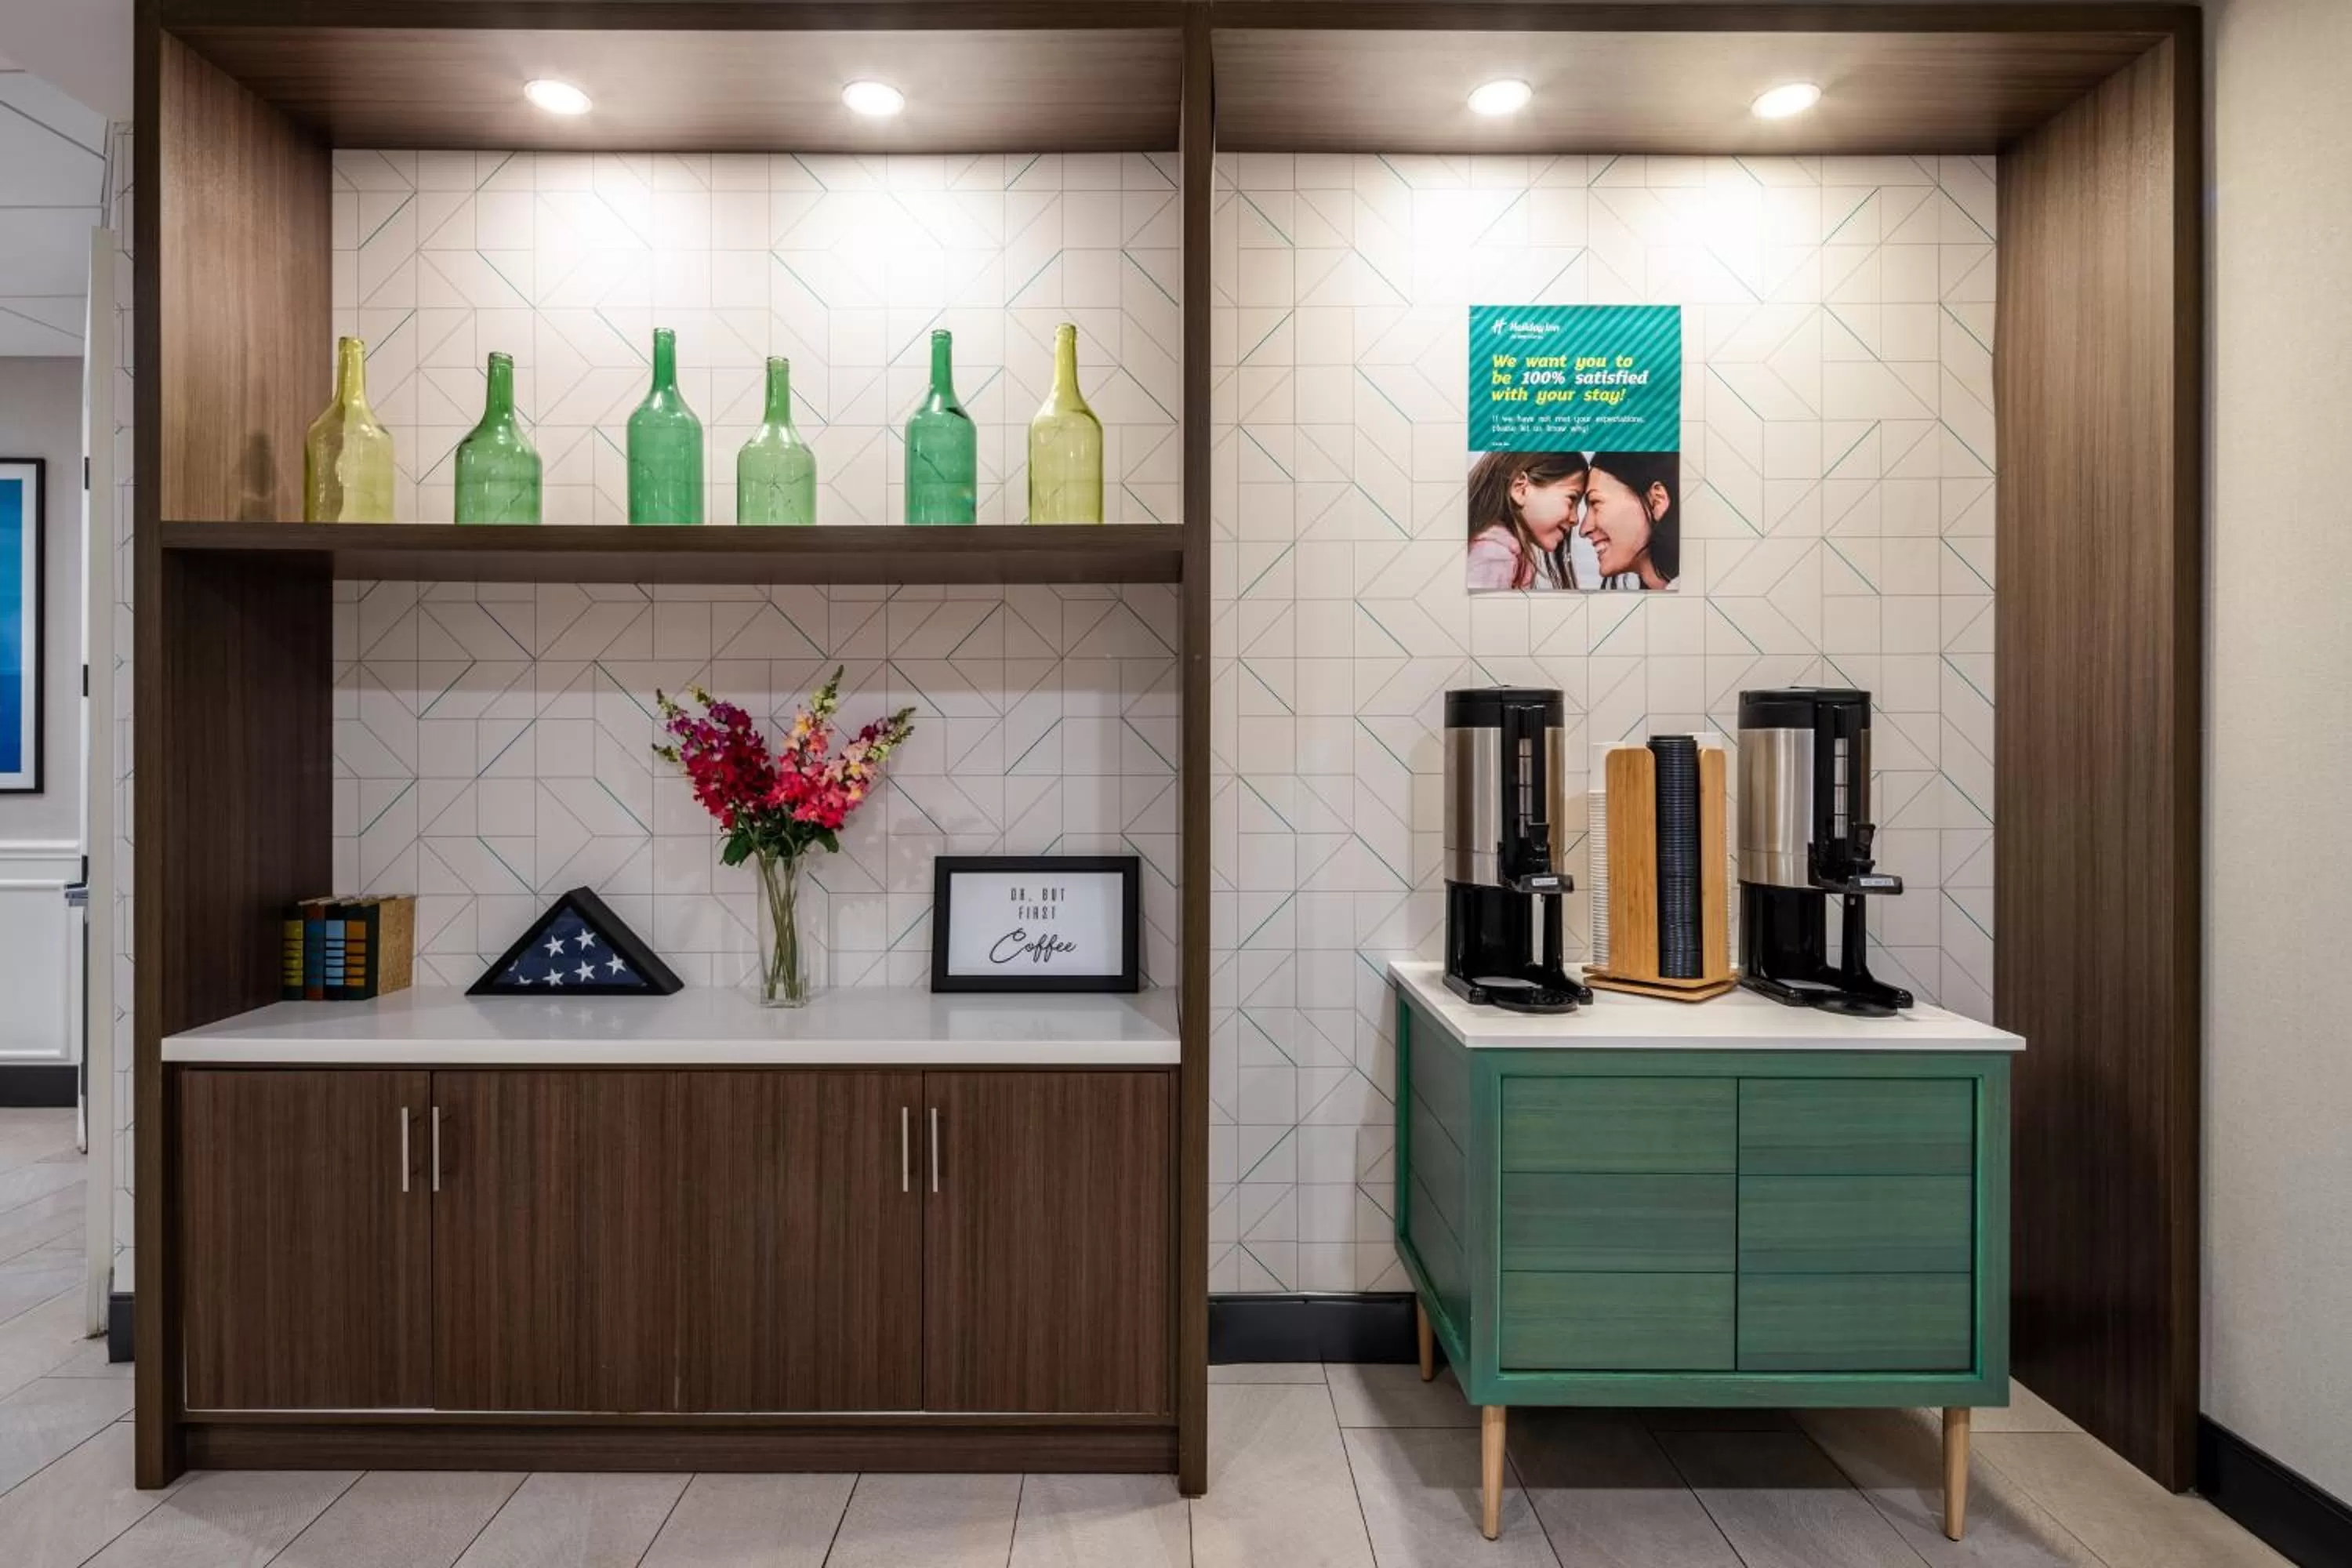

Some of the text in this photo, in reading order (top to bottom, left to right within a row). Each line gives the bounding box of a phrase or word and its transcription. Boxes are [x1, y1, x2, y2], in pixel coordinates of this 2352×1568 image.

[1493, 354, 1633, 369] We want you to
[1493, 370, 1649, 385] be 100% satisfied
[1492, 387, 1626, 405] with your stay!
[1042, 887, 1065, 902] BUT
[1018, 906, 1057, 920] FIRST
[989, 927, 1077, 964] Coffee
